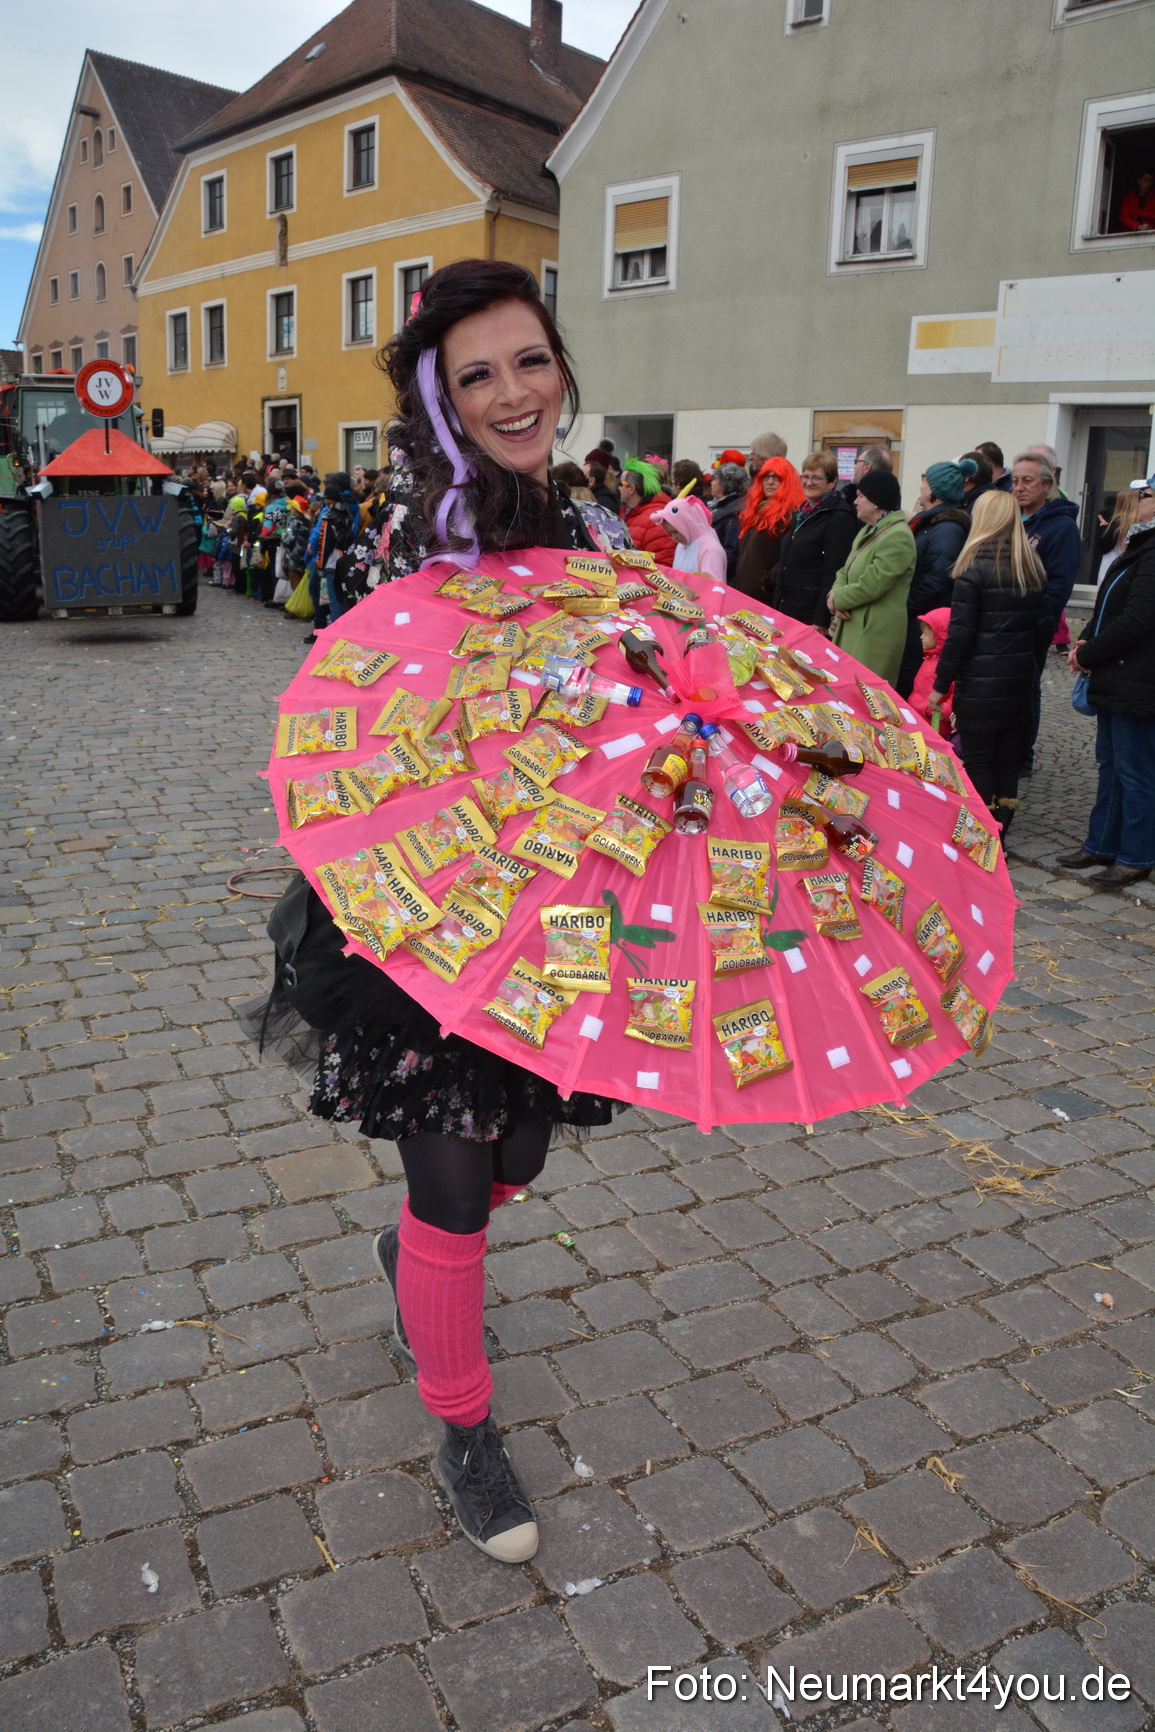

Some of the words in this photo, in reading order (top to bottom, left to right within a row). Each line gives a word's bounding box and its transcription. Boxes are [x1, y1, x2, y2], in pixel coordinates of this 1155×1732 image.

[98, 389, 112, 400] W
[354, 432, 372, 443] BW
[59, 500, 169, 536] JVW
[52, 560, 178, 602] BACHAM
[571, 561, 612, 576] HARIBO
[650, 573, 685, 599] HARIBO
[502, 622, 518, 648] HARIBO
[357, 651, 391, 682] HARIBO
[335, 711, 348, 748] HARIBO
[390, 744, 421, 778] HARIBO
[508, 747, 548, 779] GOLDBÄREN
[450, 804, 483, 843] HARIBO
[953, 807, 969, 839] HARIBO
[406, 830, 435, 870] GOLDBÄREN
[479, 845, 530, 880] HARIBO
[523, 839, 575, 868] HARIBO
[592, 834, 642, 868] GOLDBÄREN
[712, 846, 763, 861] HARIBO
[323, 867, 350, 912] GOLDBÄREN
[808, 872, 849, 887] HARIBO
[861, 857, 876, 896] HARIBO
[387, 877, 430, 924] HARIBO
[706, 910, 756, 923] HARIBO
[446, 901, 493, 938] HARIBO
[549, 915, 605, 929] HARIBO
[917, 911, 943, 945] HARIBO
[409, 938, 454, 974] GOLDBÄREN
[513, 969, 566, 1004] HARIBO
[550, 967, 607, 981] GOLDBÄREN
[871, 975, 909, 1000] HARIBO
[486, 1007, 538, 1046] GOLDBÄREN
[721, 1009, 771, 1038] HARIBO
